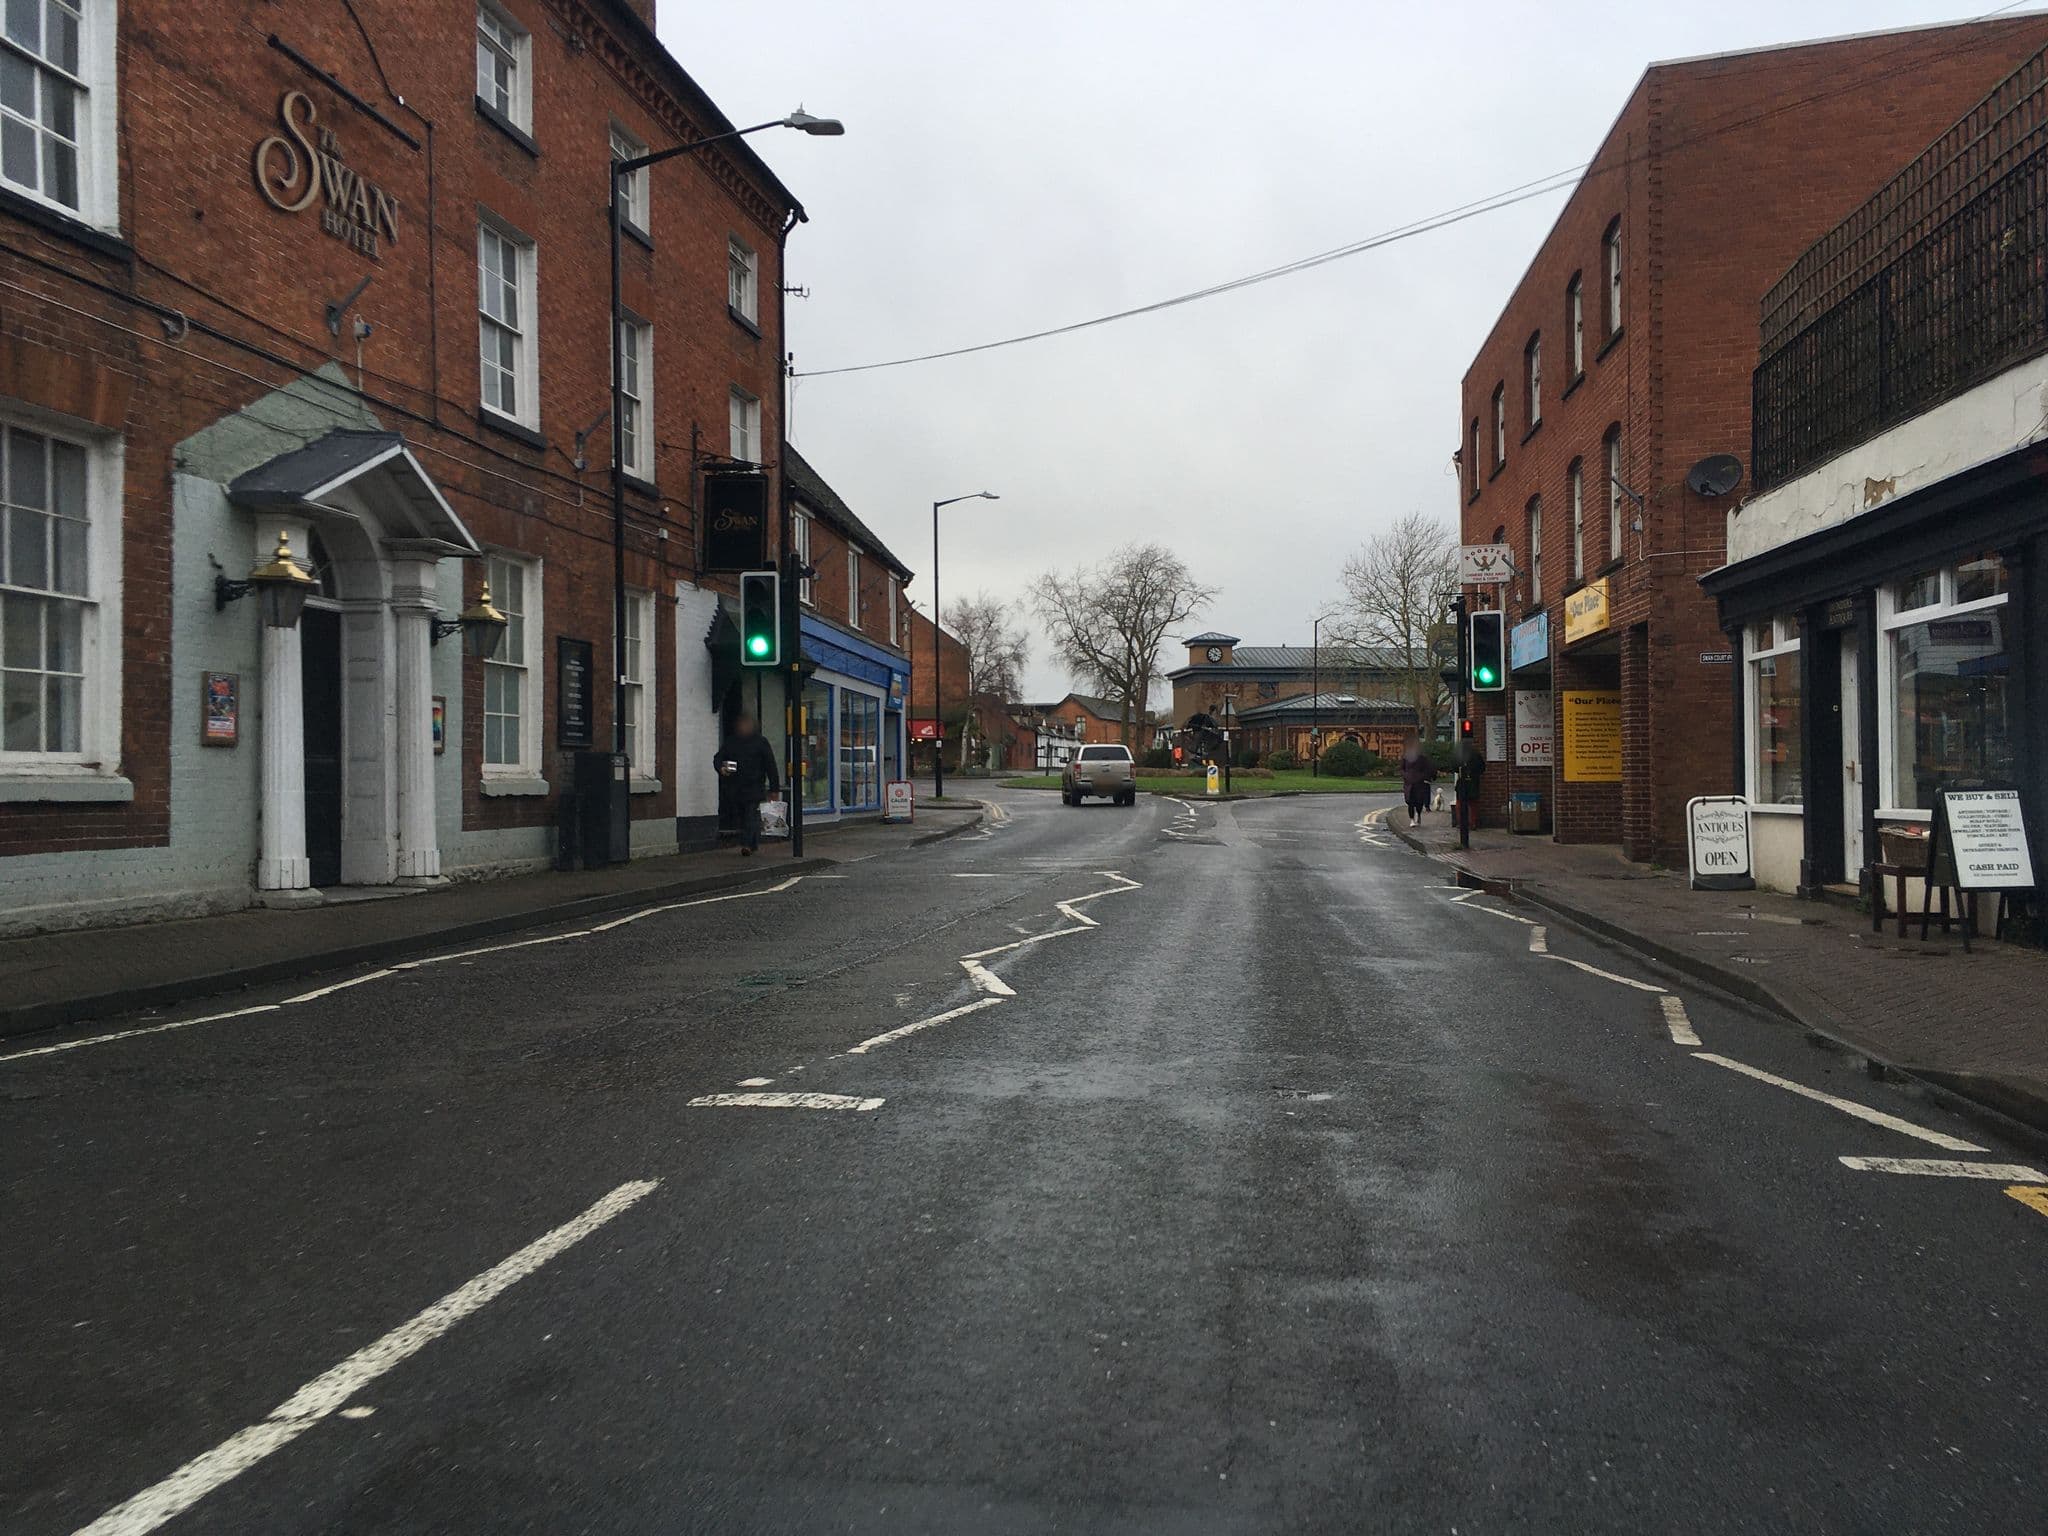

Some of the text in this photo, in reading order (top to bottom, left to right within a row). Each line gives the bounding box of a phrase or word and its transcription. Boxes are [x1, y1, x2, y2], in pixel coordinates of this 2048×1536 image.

[257, 91, 401, 244] SWAN
[320, 208, 379, 258] HOTEL
[1966, 793, 1985, 801] BUY
[1994, 792, 2019, 800] SELL
[1697, 821, 1744, 833] ANTIQUES
[1705, 851, 1738, 866] OPEN
[1969, 863, 2020, 871] CASH PAID
